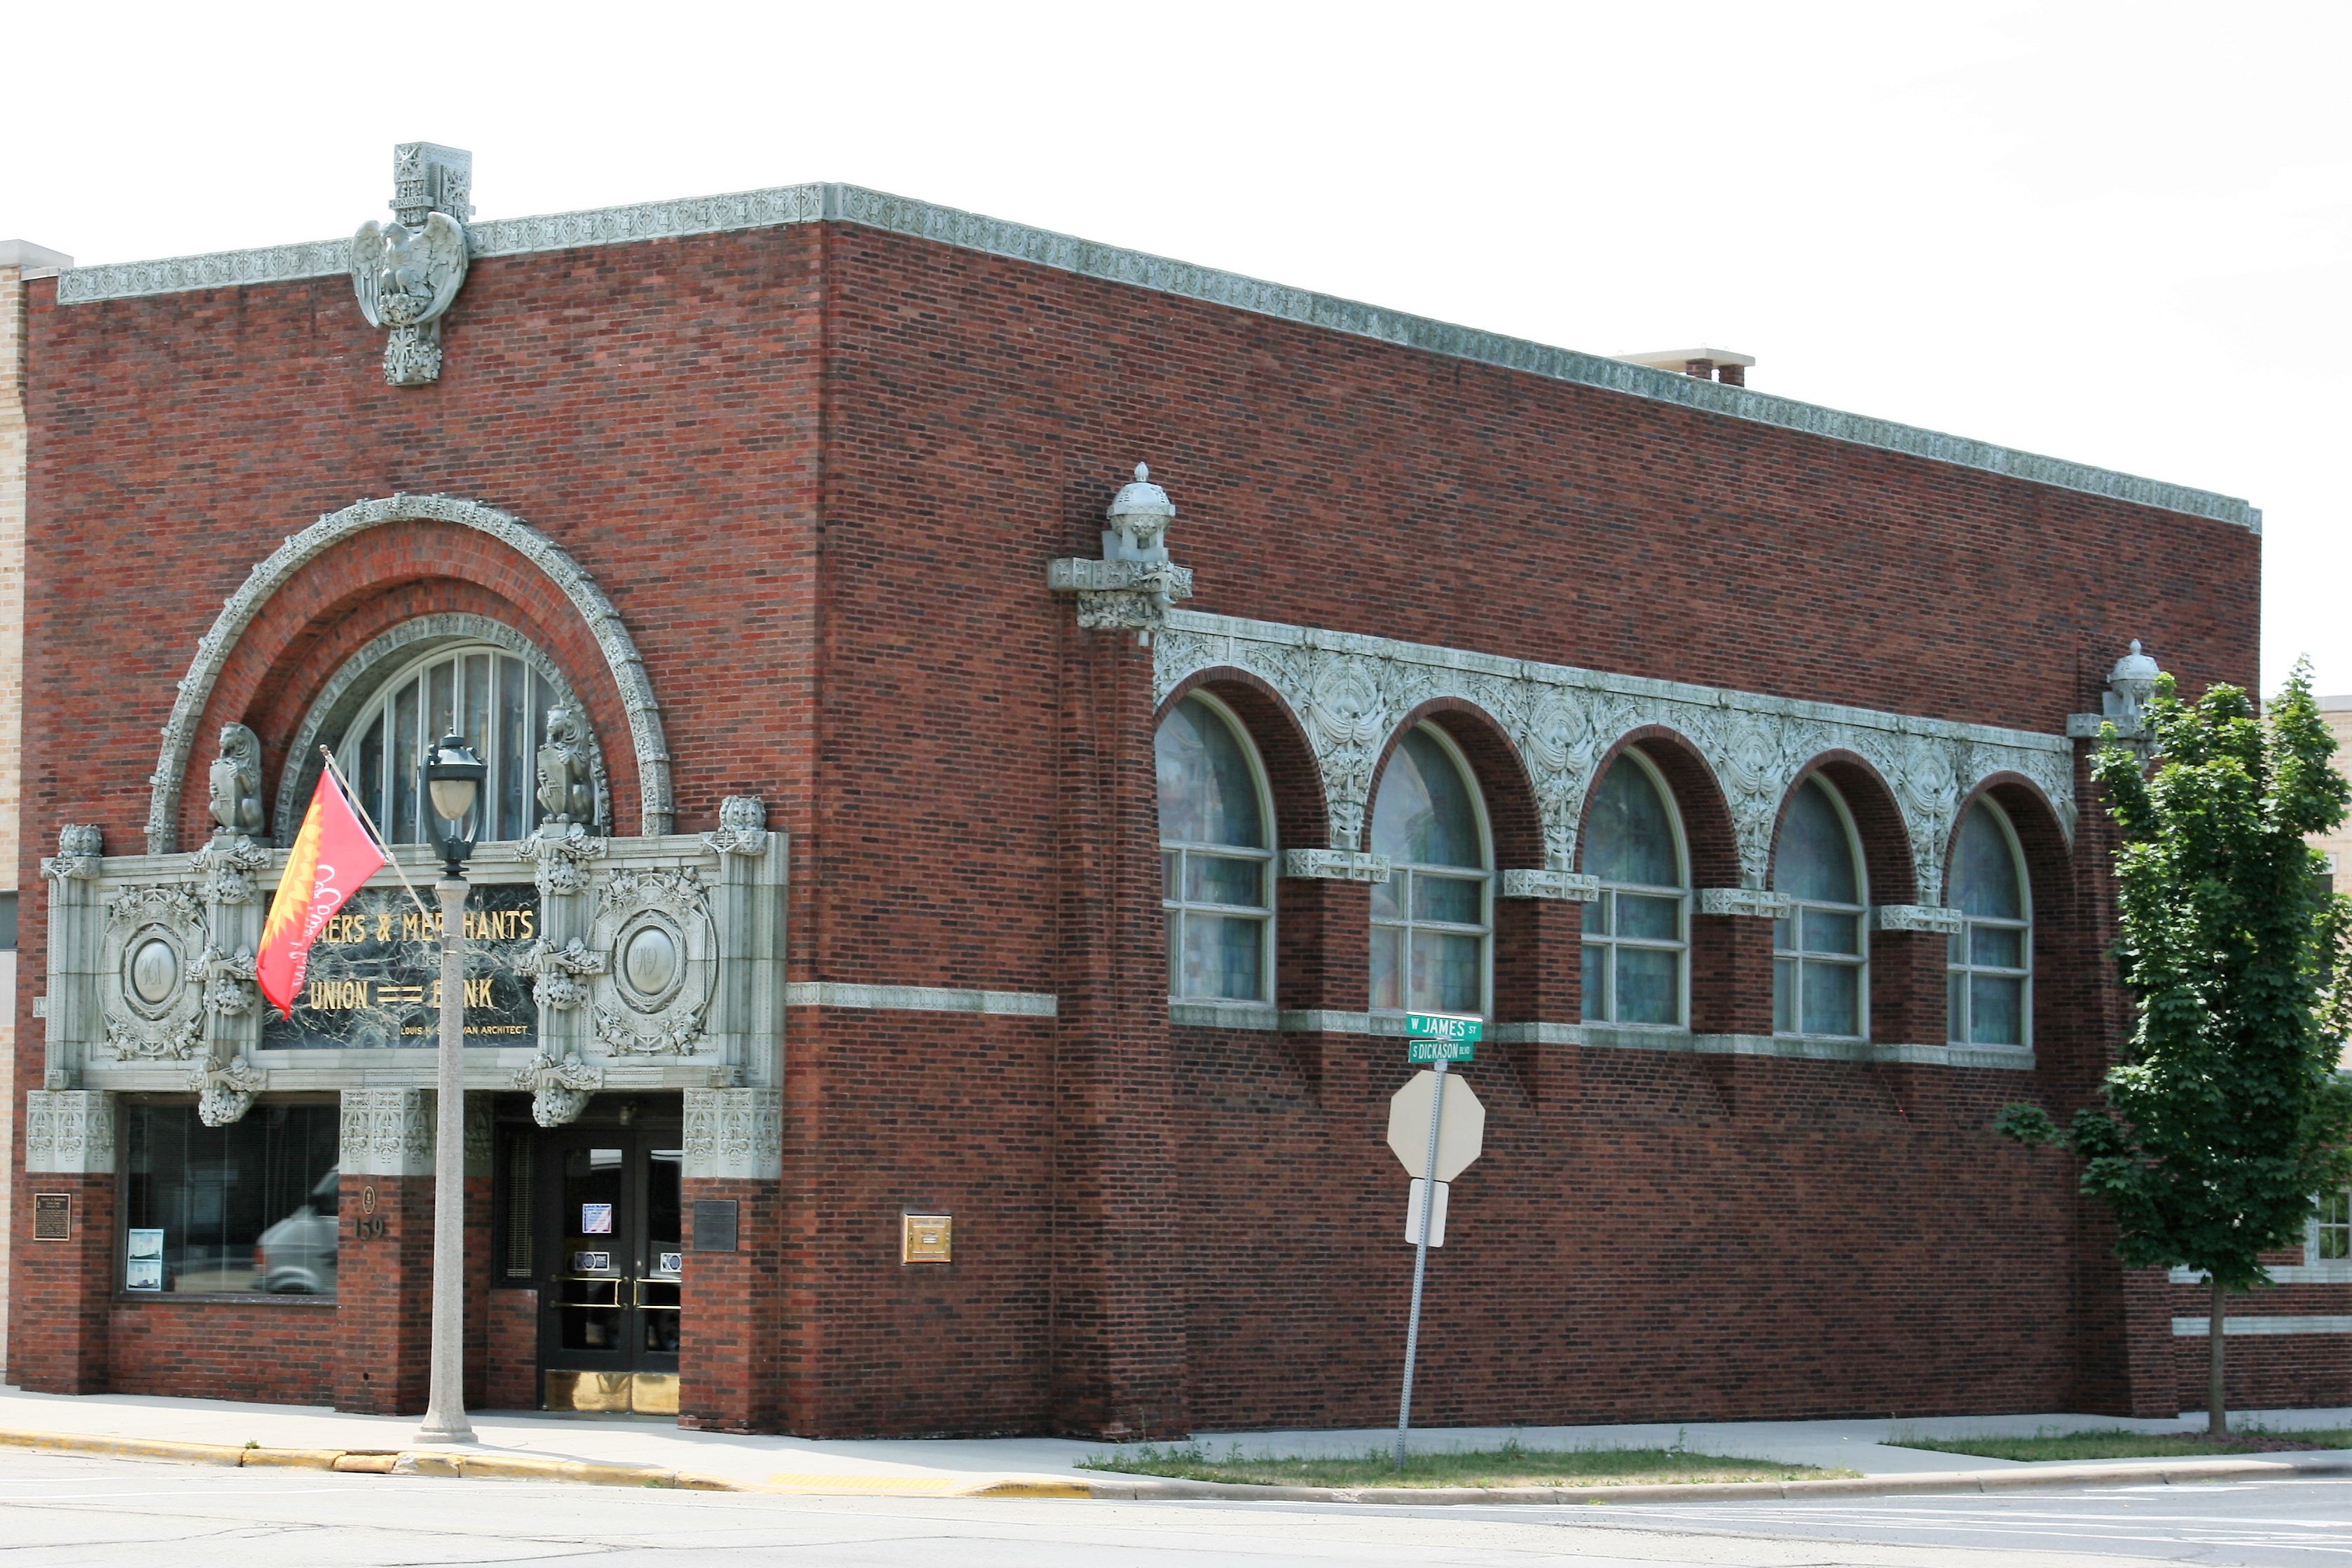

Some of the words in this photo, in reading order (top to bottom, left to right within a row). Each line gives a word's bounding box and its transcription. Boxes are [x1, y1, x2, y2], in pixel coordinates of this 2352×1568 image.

[376, 914, 392, 942] &
[402, 910, 535, 941] MEHANTS
[633, 947, 656, 975] 1919
[310, 982, 368, 1010] UNION
[432, 979, 493, 1009] BNK
[401, 1026, 422, 1036] LOUIS
[481, 1026, 528, 1034] ARCHITECT
[1411, 1018, 1419, 1029] W
[1422, 1018, 1465, 1037] JAMES
[1469, 1026, 1476, 1034] ST
[1412, 1045, 1417, 1057] S
[1418, 1043, 1459, 1059] DICKASON
[1459, 1046, 1470, 1054] BLVD
[354, 1217, 383, 1240] 159
